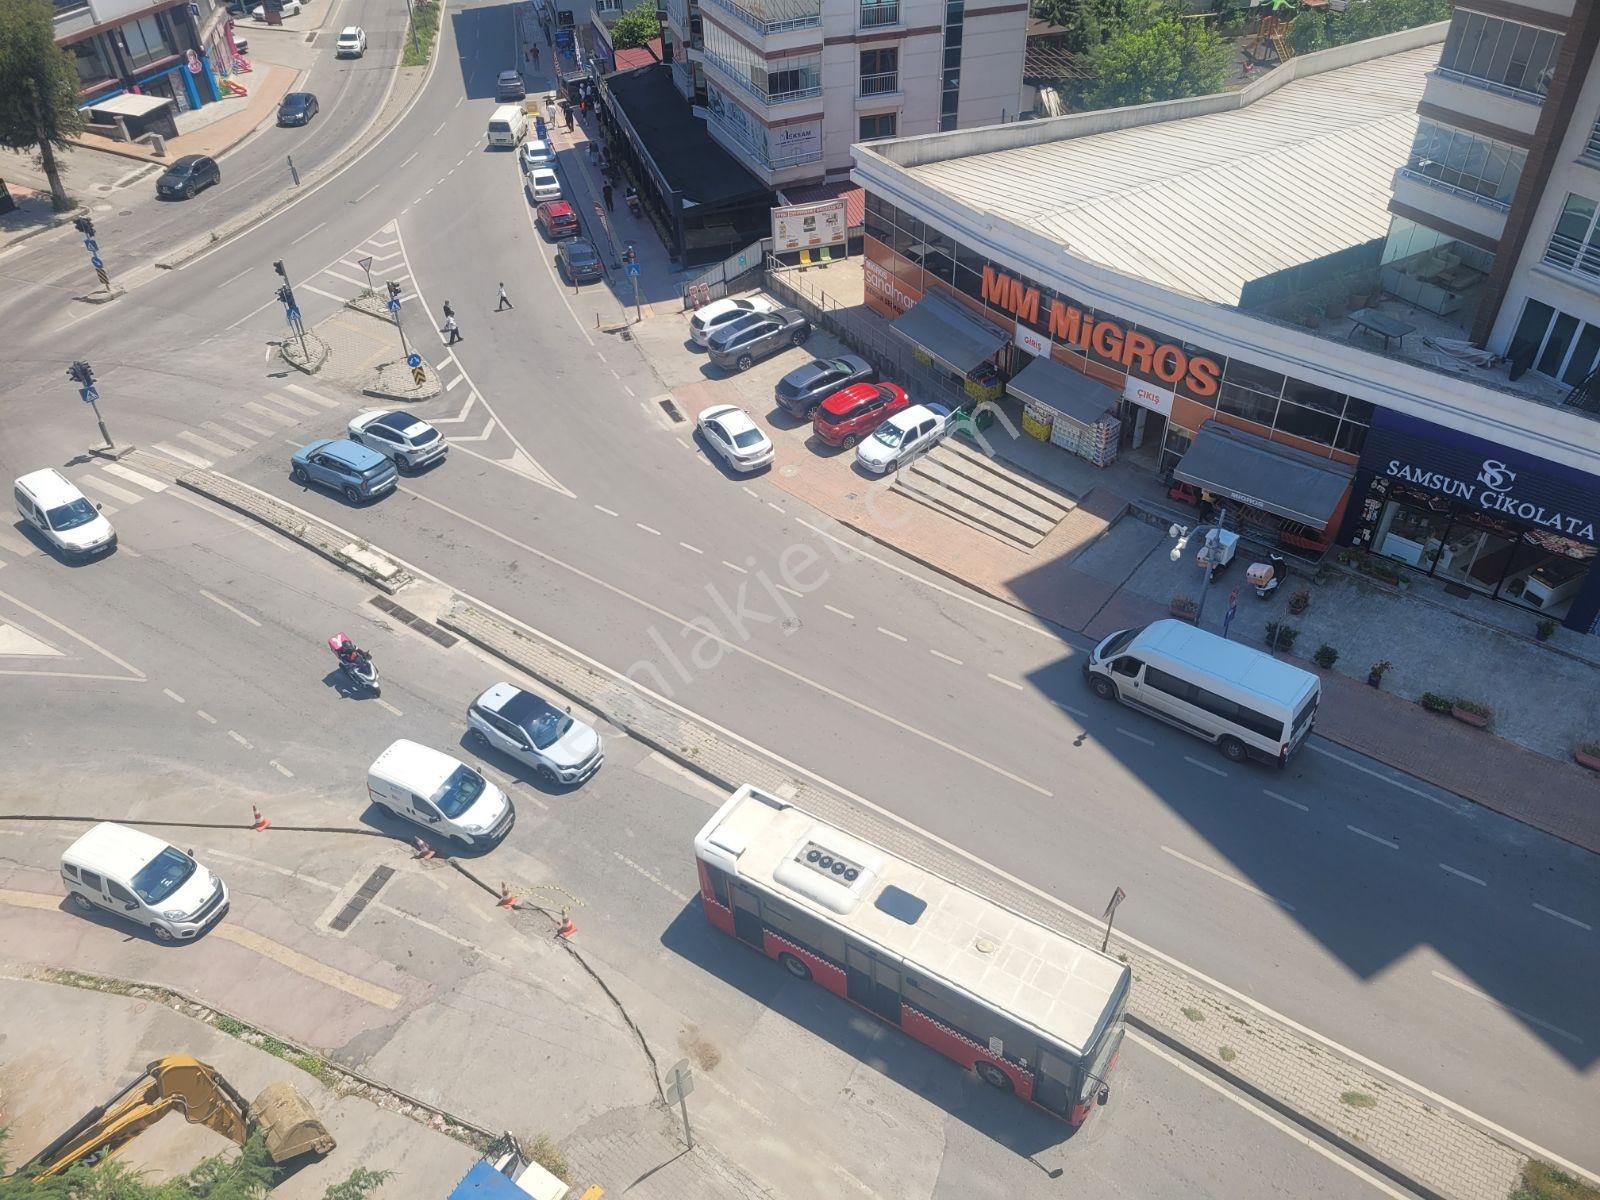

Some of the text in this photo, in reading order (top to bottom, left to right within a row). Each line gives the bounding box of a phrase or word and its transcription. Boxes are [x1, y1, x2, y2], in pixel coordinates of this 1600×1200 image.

[981, 264, 1040, 324] MM
[1137, 389, 1160, 405] ÇIKIŞ
[1386, 460, 1595, 541] SAMSUN ÇİKOLATA
